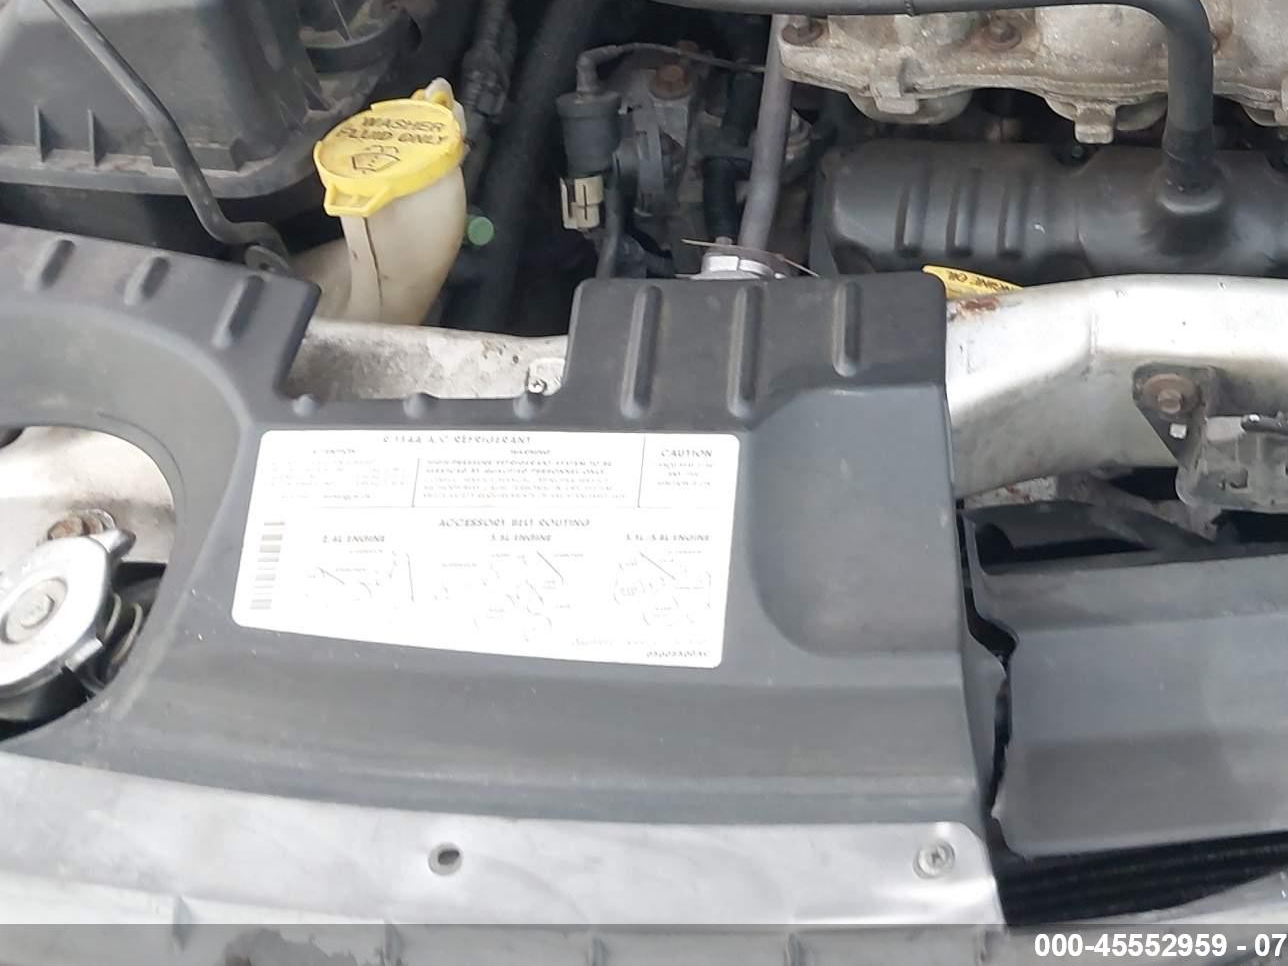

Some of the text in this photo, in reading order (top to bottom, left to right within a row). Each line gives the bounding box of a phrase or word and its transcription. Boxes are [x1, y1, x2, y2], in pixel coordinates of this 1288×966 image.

[362, 117, 445, 132] WASHER
[336, 126, 447, 145] FLUID ONLY
[661, 449, 712, 458] CAUTION
[439, 518, 505, 527] ACCESSORY
[511, 518, 534, 527] BELT
